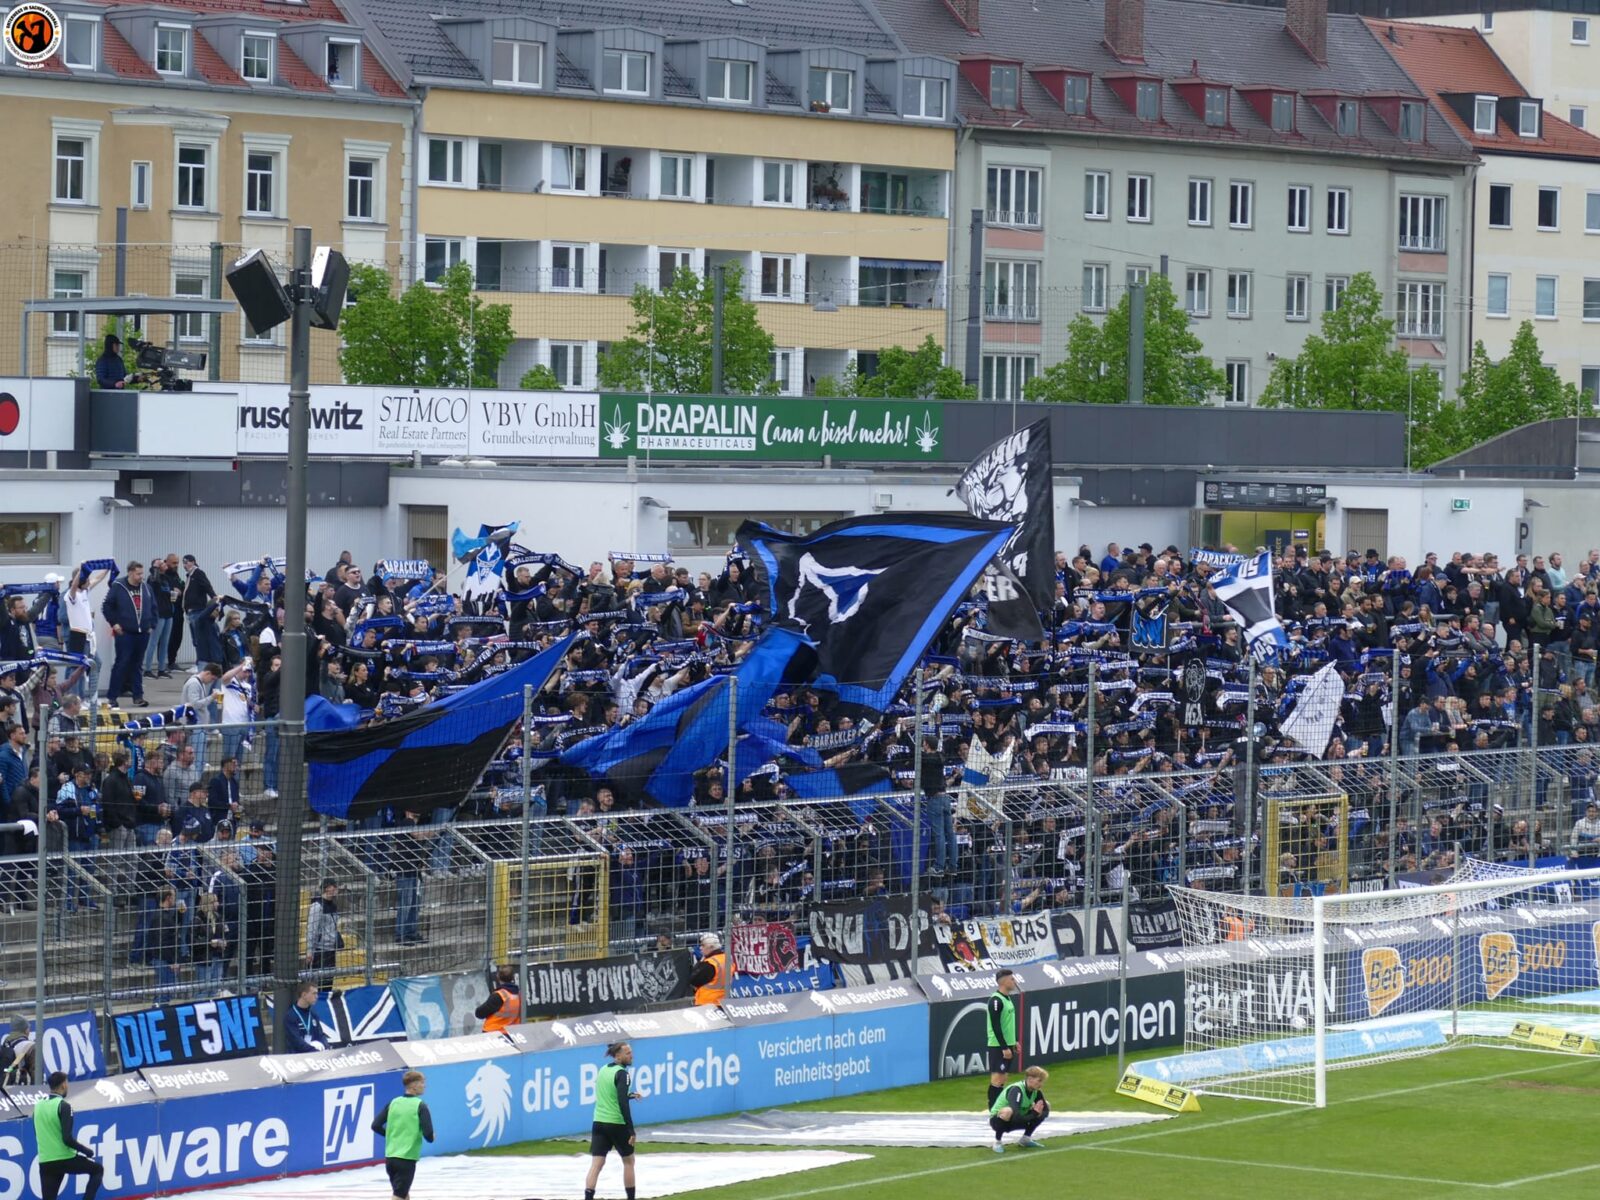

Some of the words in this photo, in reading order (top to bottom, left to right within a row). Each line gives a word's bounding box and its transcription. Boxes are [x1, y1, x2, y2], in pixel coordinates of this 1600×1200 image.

[379, 396, 468, 424] STIMCO
[482, 402, 526, 426] VBV
[534, 403, 596, 428] GmbH
[637, 403, 757, 435] DRAPALIN
[379, 425, 399, 440] Real
[401, 426, 428, 441] Estate
[431, 427, 467, 442] Partners
[482, 430, 595, 448] Grundbesitzverwaltung
[762, 414, 804, 446] Cann
[807, 425, 821, 442] a
[640, 437, 753, 450] PHARMACEUTICALS
[850, 984, 909, 1005] Bayerische
[727, 1000, 788, 1020] Bayerische
[115, 1008, 173, 1069] DIE
[175, 996, 260, 1055] F5NF
[575, 1021, 595, 1037] die
[1030, 999, 1176, 1057] München
[758, 1032, 822, 1060] Versichert
[825, 1029, 855, 1050] nach
[859, 1026, 886, 1045] dem
[309, 1047, 384, 1072] Bayerische
[775, 1055, 871, 1087] Reinheitsgebot
[944, 1051, 990, 1078] MA
[124, 1076, 149, 1093] die
[150, 1068, 229, 1091] Bayerische
[523, 1066, 570, 1113] die
